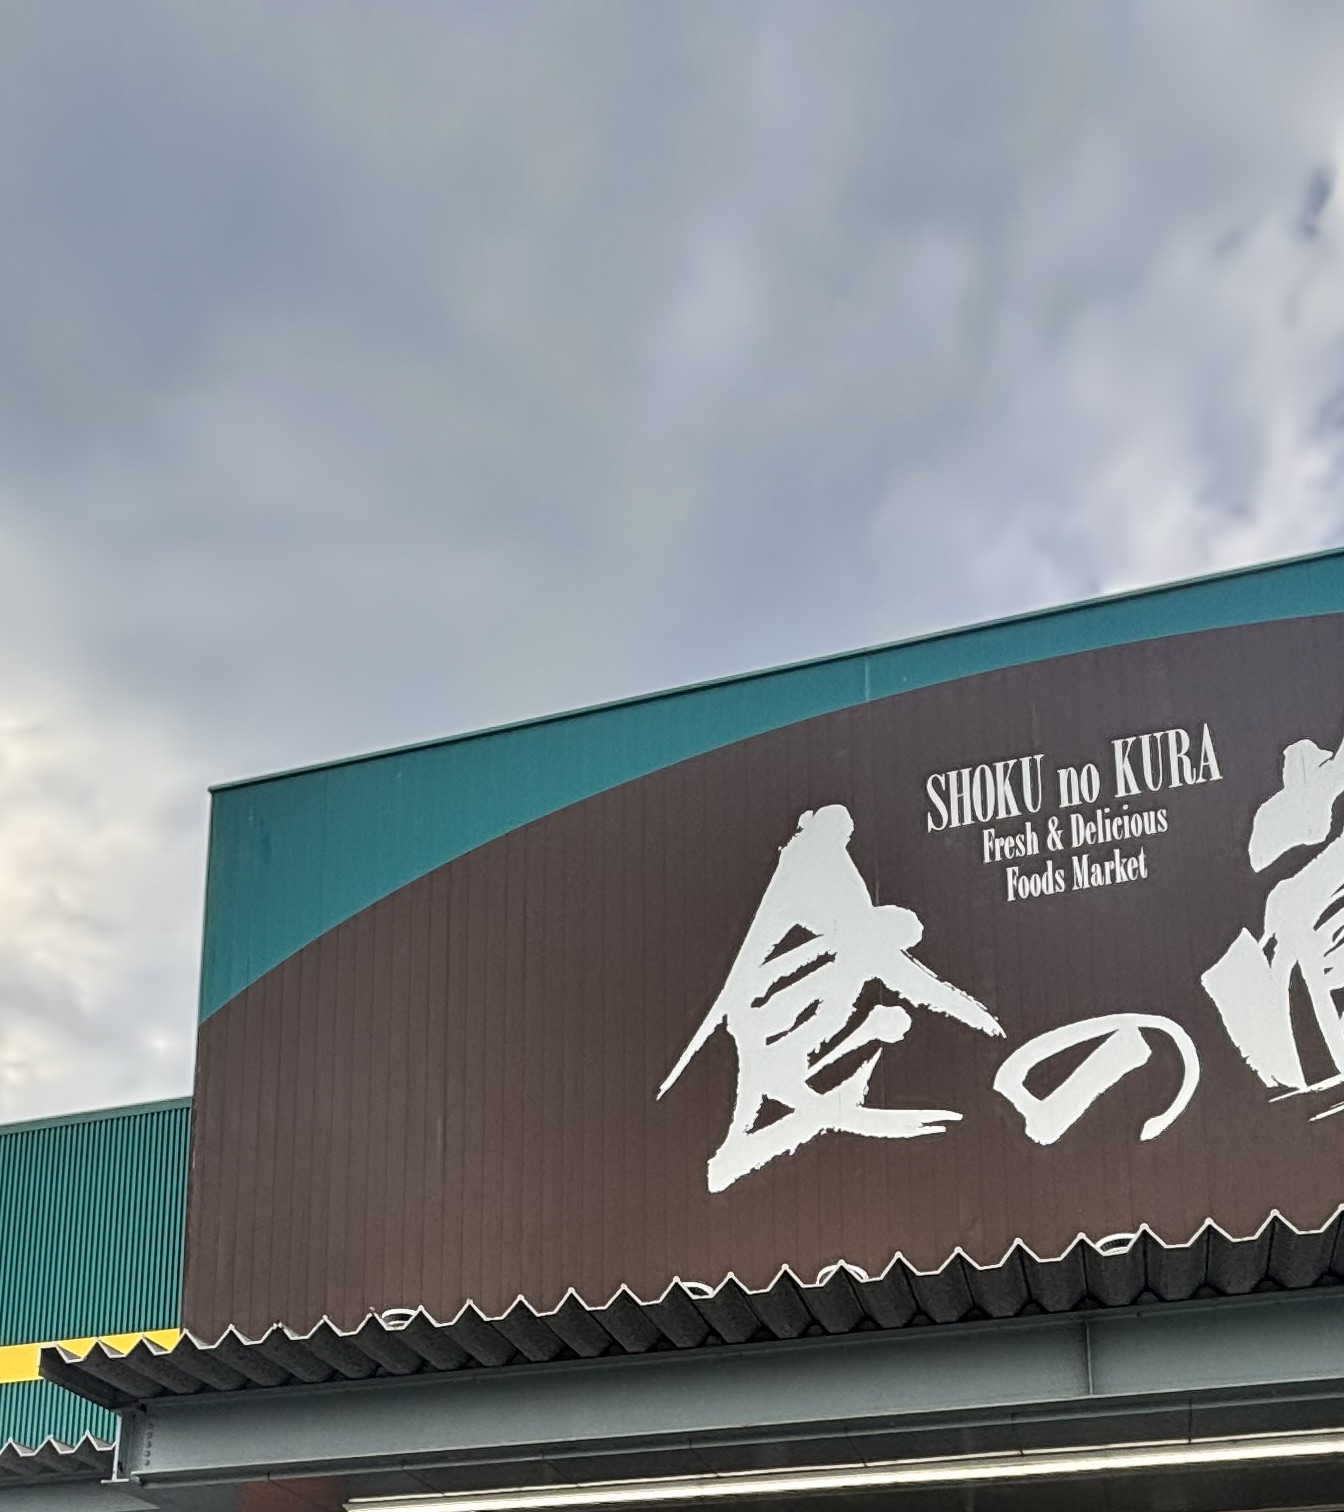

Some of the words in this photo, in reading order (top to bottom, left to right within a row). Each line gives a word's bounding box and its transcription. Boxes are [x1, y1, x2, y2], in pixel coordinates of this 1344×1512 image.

[926, 753, 1045, 833] SHOKU
[1057, 762, 1102, 809] no
[1110, 722, 1224, 798] KURA
[982, 821, 1040, 865] Fresh
[1046, 815, 1065, 853] &
[1070, 803, 1169, 849] Delicious
[1006, 859, 1066, 902] Foods
[1071, 845, 1149, 891] Market
